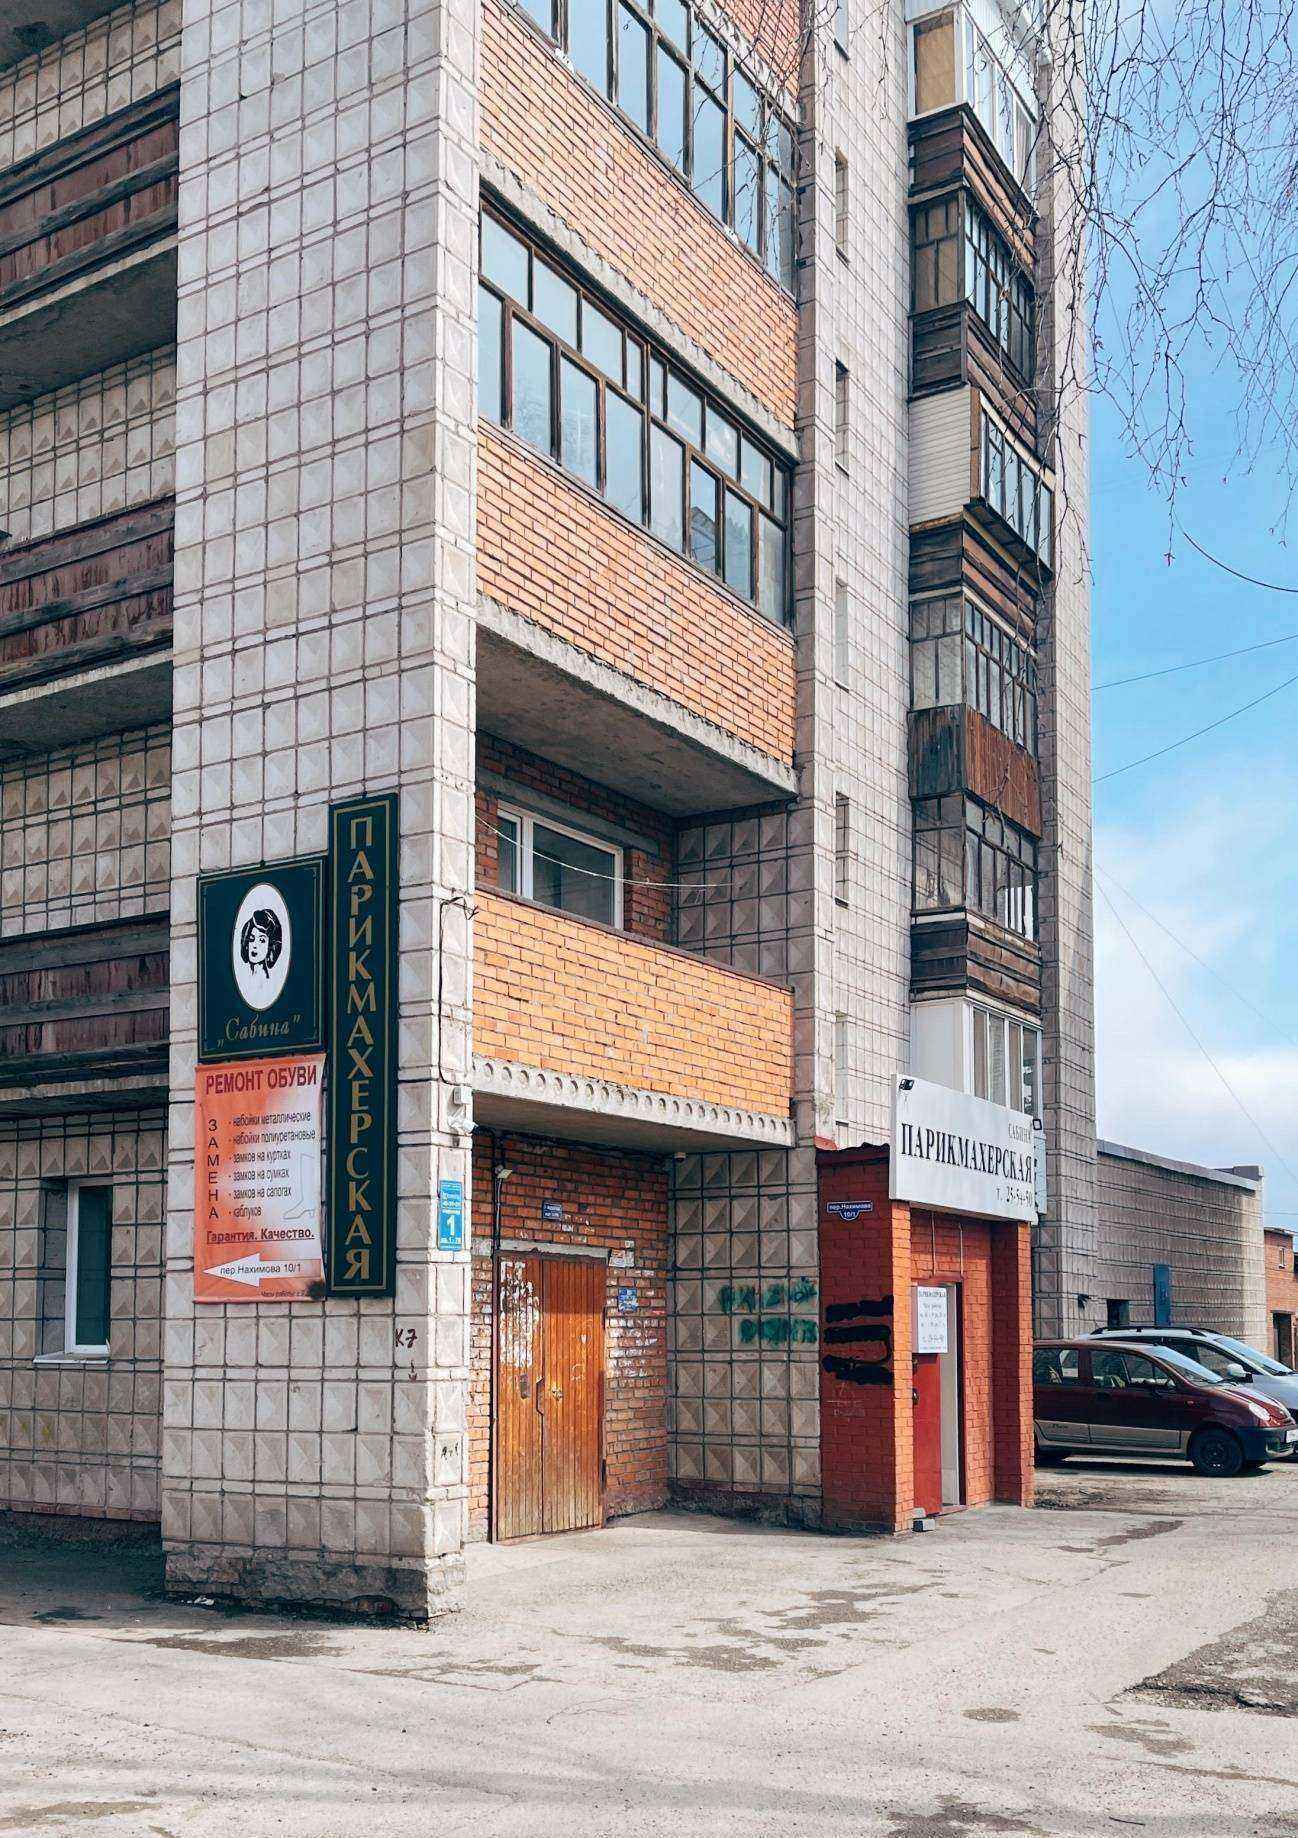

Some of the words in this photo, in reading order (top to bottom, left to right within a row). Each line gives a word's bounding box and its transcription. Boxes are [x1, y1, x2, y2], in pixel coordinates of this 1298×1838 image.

[344, 815, 377, 1281] ПАРИКМАХЕРСКАЯ
[206, 1070, 264, 1095] РЕМОНТ
[267, 1064, 317, 1090] ОБУВИ
[233, 1113, 260, 1127] набойки
[262, 1111, 312, 1125] металлические
[233, 1131, 260, 1146] набойки
[261, 1130, 316, 1147] полиуретановые
[233, 1151, 256, 1164] замков
[257, 1151, 265, 1162] на
[266, 1149, 291, 1164] куртках
[901, 1122, 1032, 1184] ПАРИКМАХЕРСКАЯ
[207, 1118, 220, 1219] ЗАМЕНА
[233, 1169, 256, 1182] замков
[257, 1169, 265, 1180] на
[266, 1168, 290, 1182] сумках
[233, 1187, 256, 1200] замков
[257, 1187, 265, 1198] на
[266, 1186, 292, 1199] сапогах
[447, 1214, 455, 1236] 1
[207, 1230, 258, 1243] Гарантия.
[261, 1228, 315, 1240] Качество.
[238, 1263, 281, 1274] Нахимова
[284, 1263, 301, 1273] 10/1
